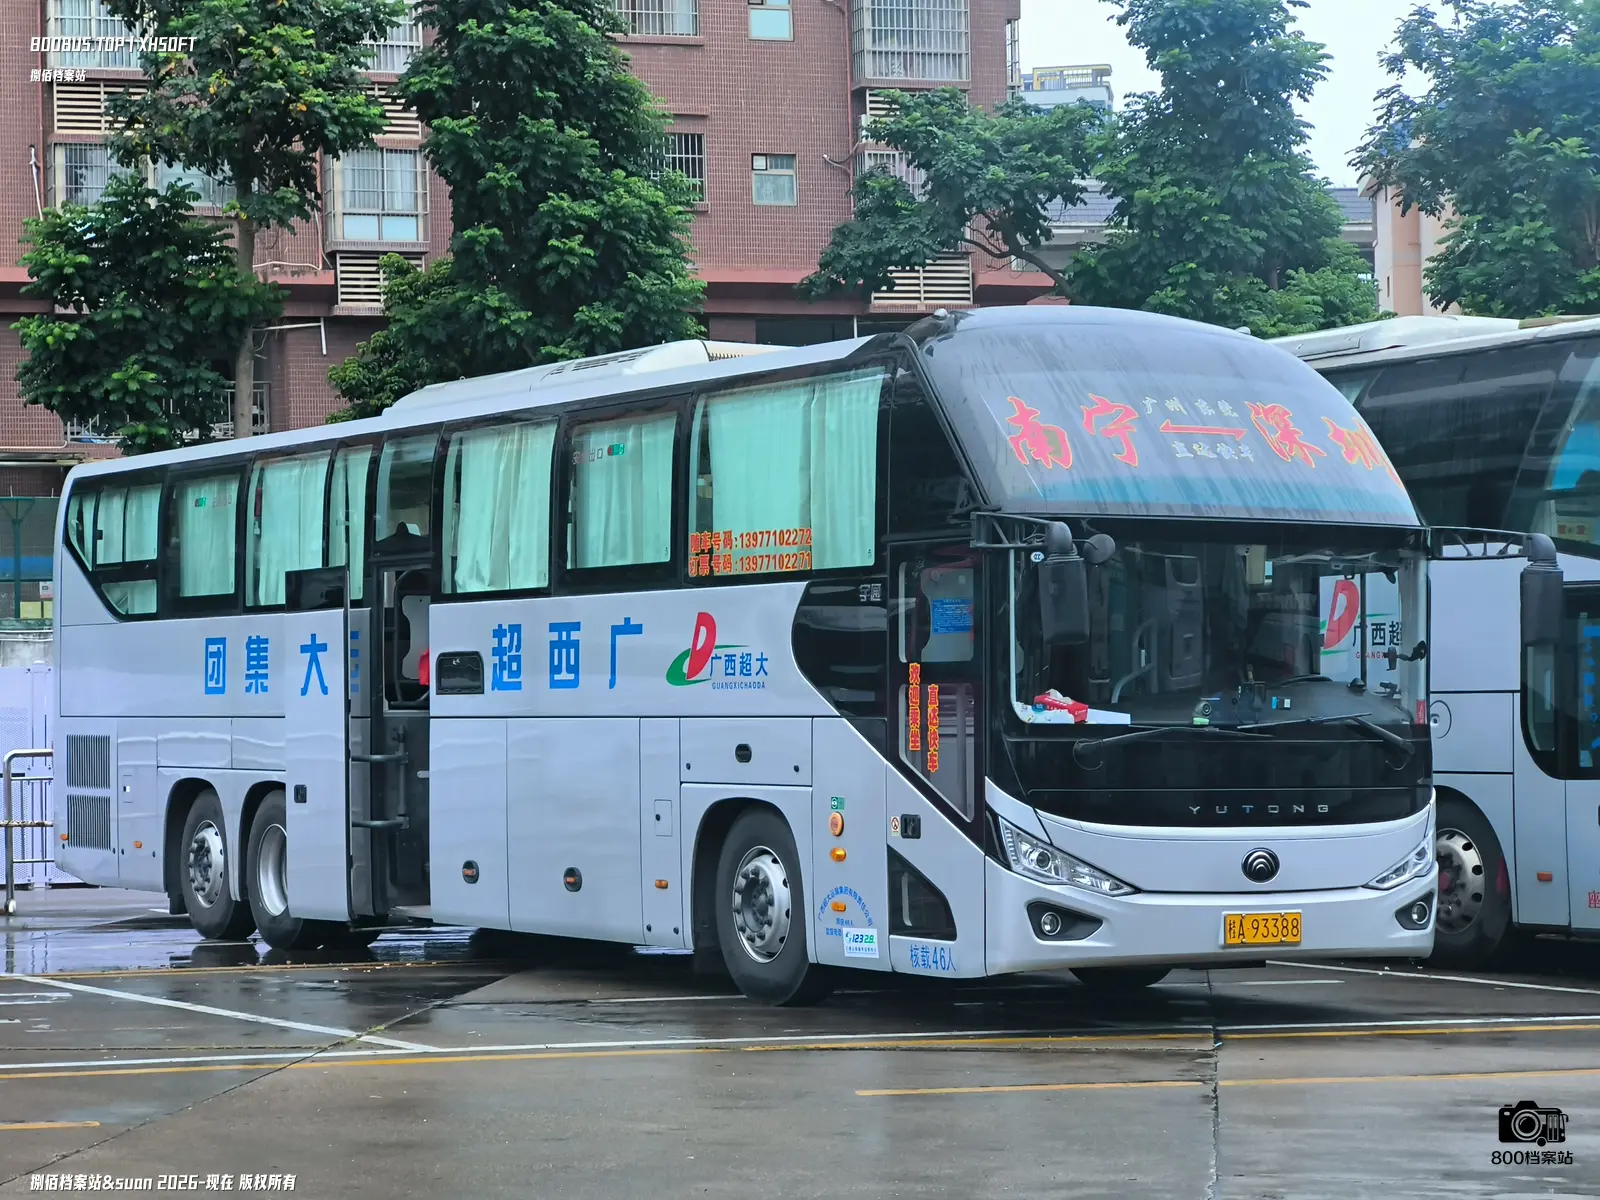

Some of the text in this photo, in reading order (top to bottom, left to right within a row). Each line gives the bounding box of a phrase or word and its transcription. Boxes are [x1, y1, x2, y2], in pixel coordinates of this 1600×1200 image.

[1007, 393, 1140, 470] 南宁
[709, 652, 769, 678] 广西超大
[711, 681, 766, 690] GUANGXICHAODA
[927, 684, 939, 772] 直达快车
[1189, 804, 1329, 814] YUTONG
[909, 944, 956, 972] 核载46人
